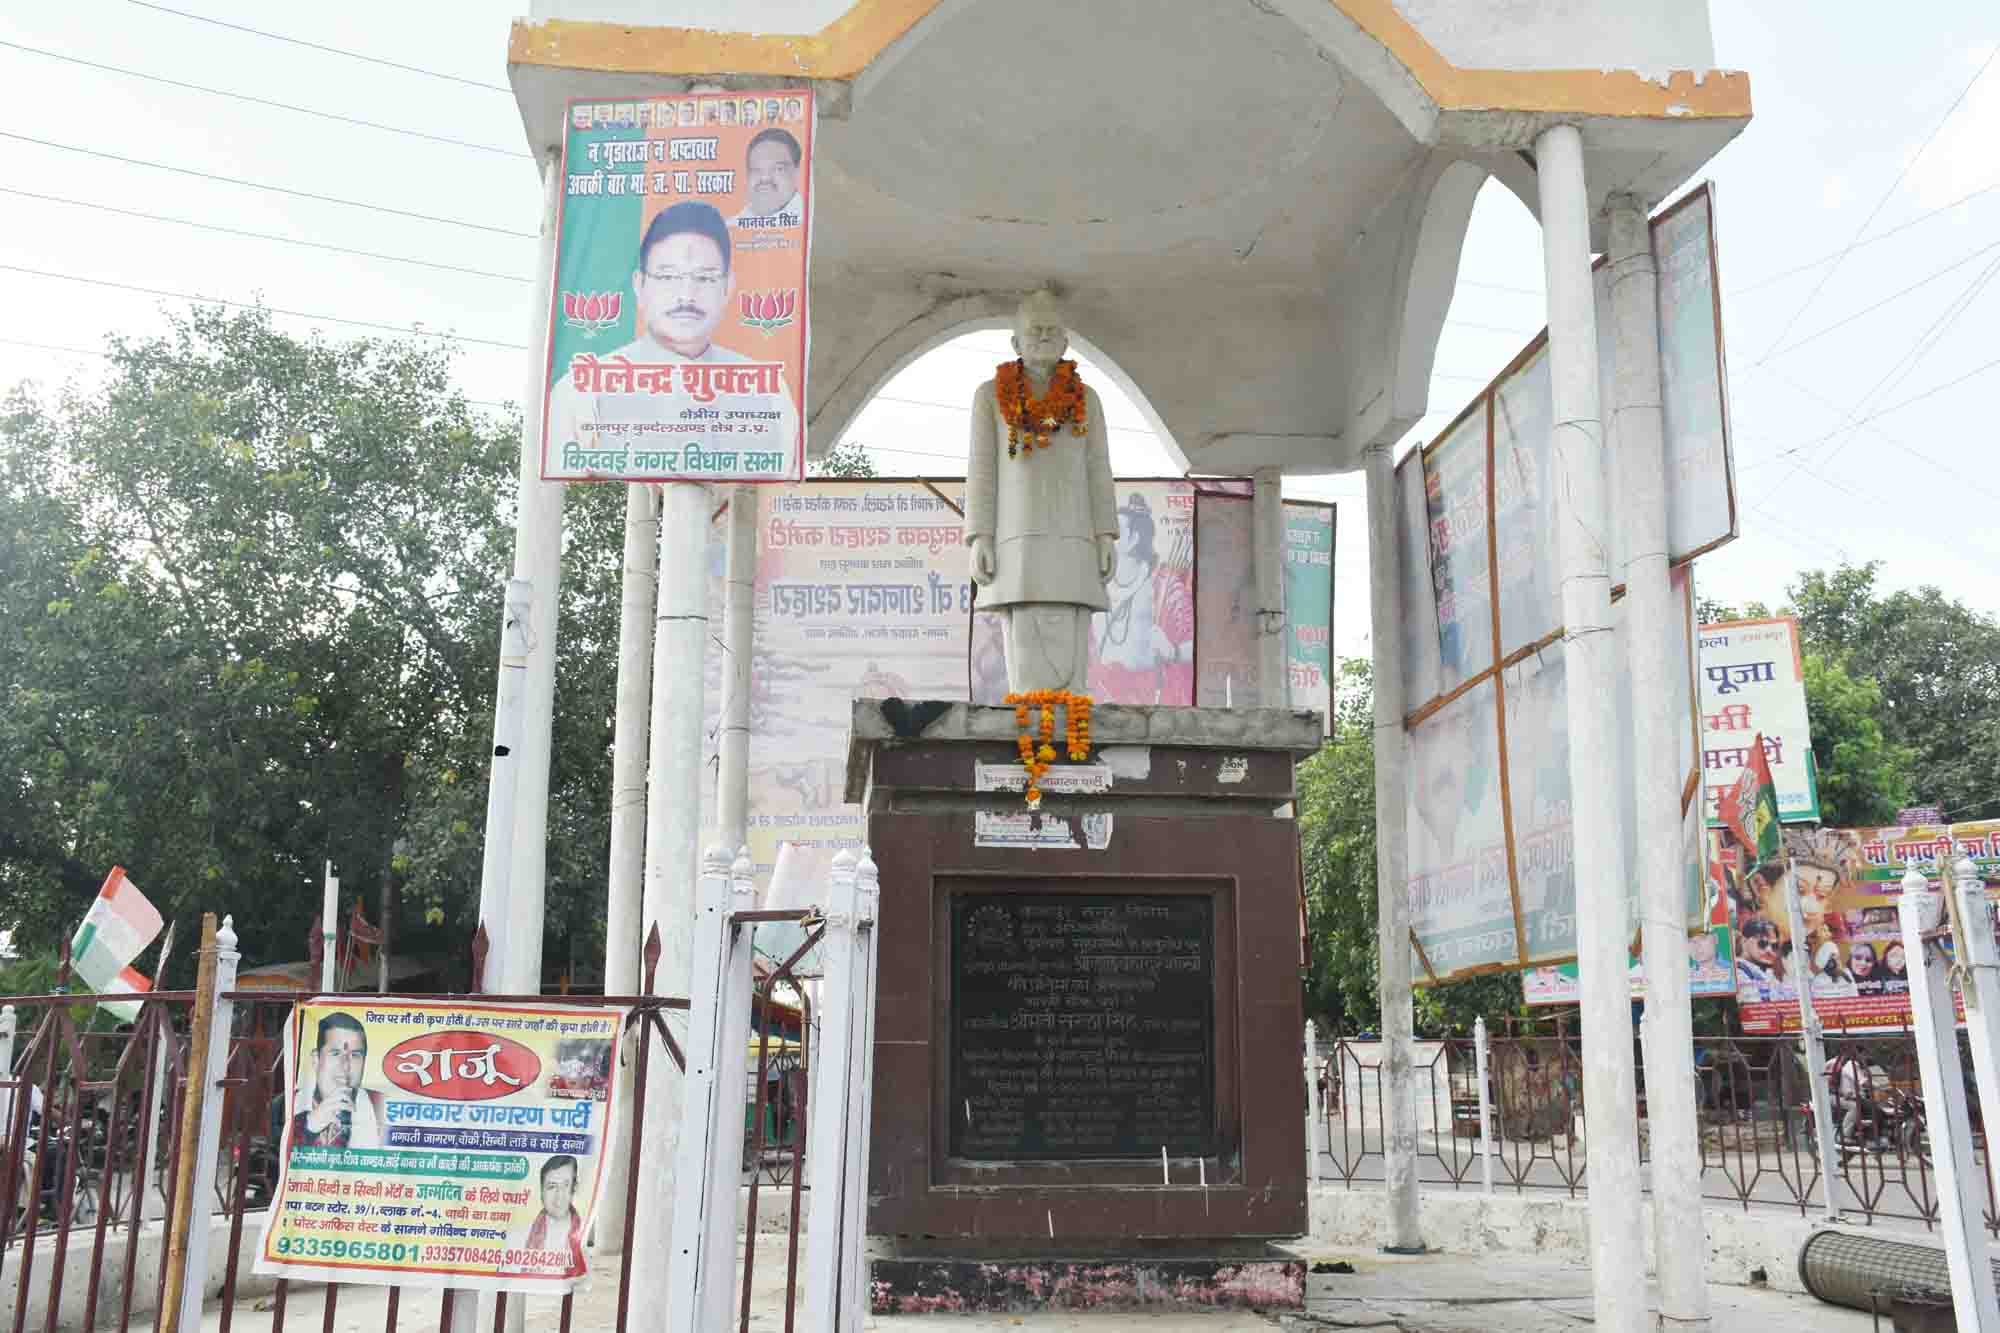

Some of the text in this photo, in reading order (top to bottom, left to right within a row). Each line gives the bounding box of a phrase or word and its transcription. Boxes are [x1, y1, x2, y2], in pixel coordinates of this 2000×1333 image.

[587, 142, 598, 163] न
[653, 140, 665, 161] न
[568, 170, 603, 195] अबकी
[607, 173, 625, 195] बार
[696, 170, 735, 193] सरकार
[572, 354, 784, 401] शैलेन्द्र शुक्ला
[680, 408, 781, 419] क्षेत्रीय उपाध्यक्ष
[581, 423, 630, 436] कानपुर
[711, 422, 733, 433] क्षेत्र
[563, 441, 784, 472] किदवई नगर विधान सभा
[1705, 661, 1775, 694] पूजा
[366, 1011, 384, 1024] जिस
[387, 1014, 399, 1024] पर
[413, 1011, 425, 1024] की
[427, 1014, 444, 1027] कृपा
[560, 1021, 578, 1034] कृपा
[580, 1020, 598, 1033] होती
[396, 1043, 521, 1087] राजू
[386, 1101, 592, 1129] झनकार जागरण पार्टी
[391, 1130, 420, 1144] भगवती
[317, 1179, 340, 1195] हिन्दी
[343, 1184, 351, 1194] व
[354, 1179, 382, 1196] सिन्धी
[405, 1187, 414, 1198] व
[416, 1179, 464, 1200] जन्मदिन
[465, 1189, 476, 1202] के
[380, 1220, 391, 1233] के
[394, 1221, 426, 1236] सामने
[430, 1221, 467, 1239] गोविन्द
